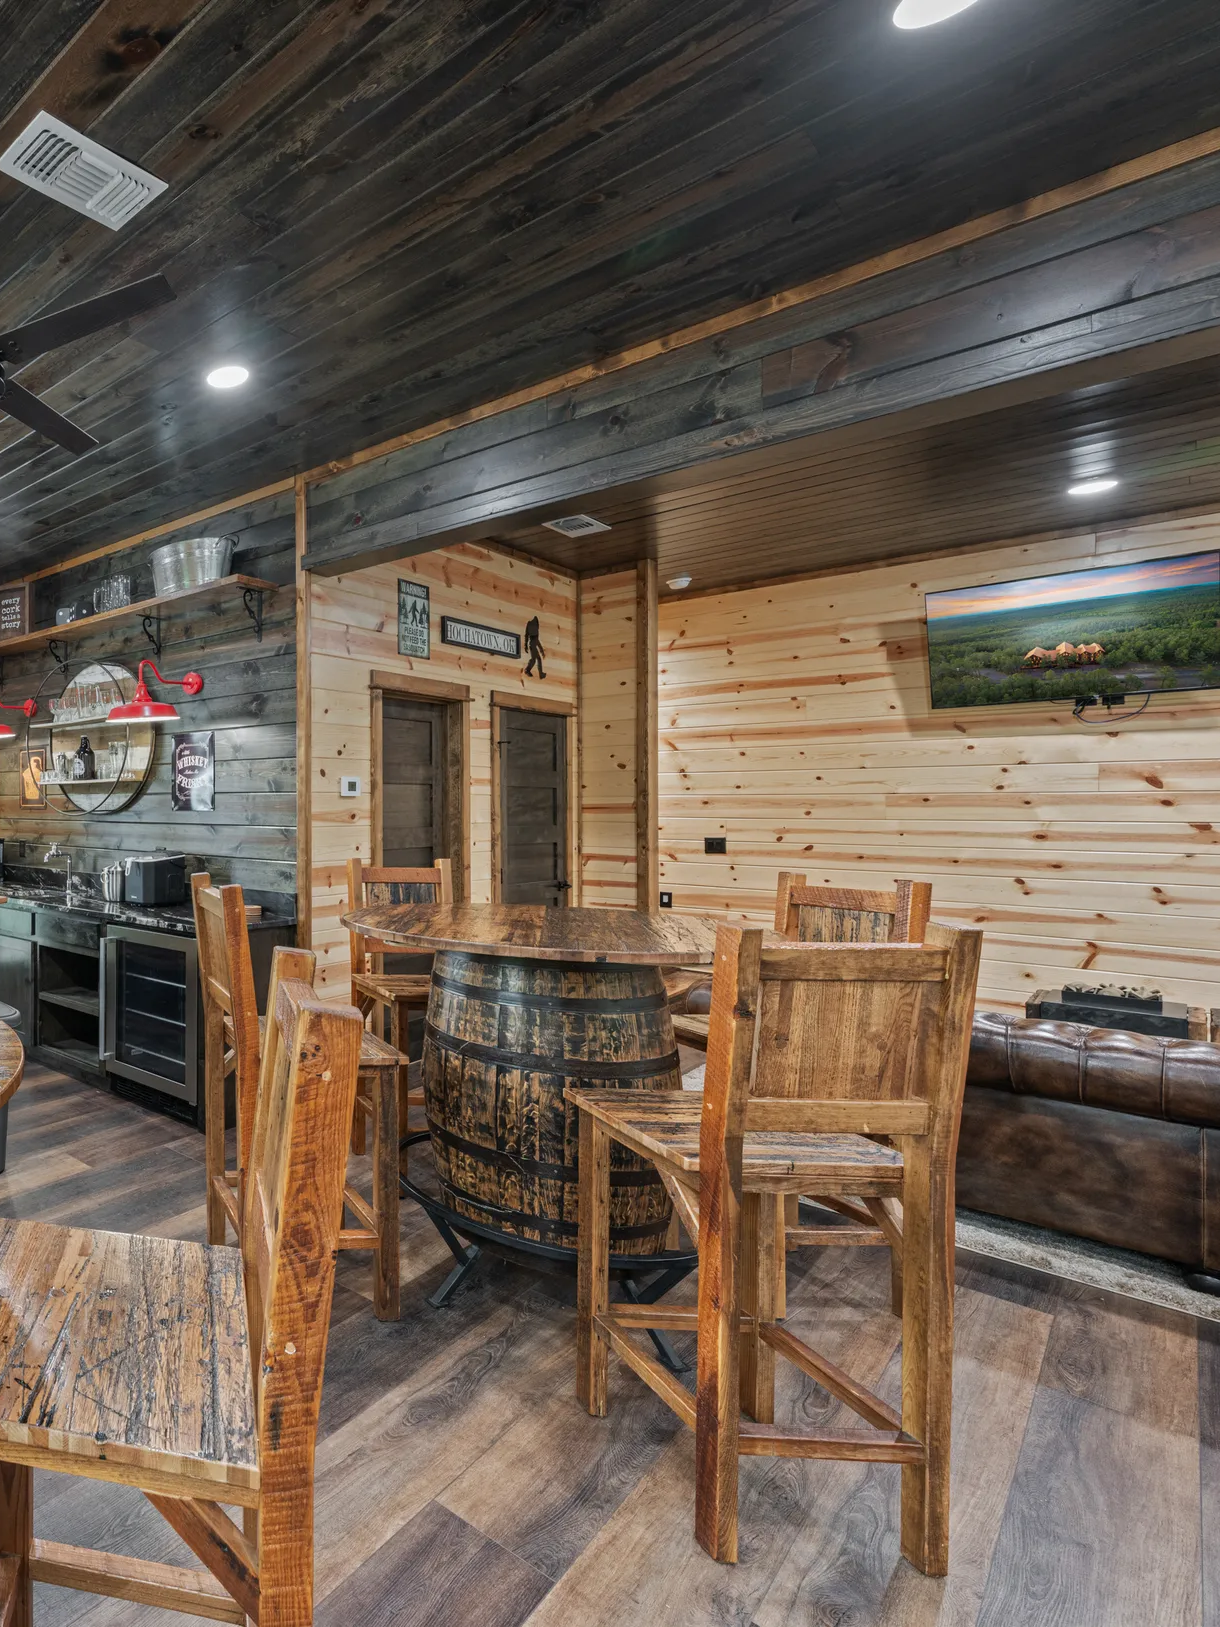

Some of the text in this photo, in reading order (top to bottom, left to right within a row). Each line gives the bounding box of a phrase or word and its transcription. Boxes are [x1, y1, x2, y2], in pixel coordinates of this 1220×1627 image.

[400, 581, 427, 598] WARNING!
[1, 597, 20, 605] every
[2, 604, 20, 614] cork
[1, 621, 21, 629] story
[404, 626, 424, 637] PLEASE DO
[402, 634, 427, 646] NOT FEED THE
[503, 637, 515, 653] OK
[403, 643, 425, 654] SASQUATCH
[177, 755, 209, 770] WHISKEY
